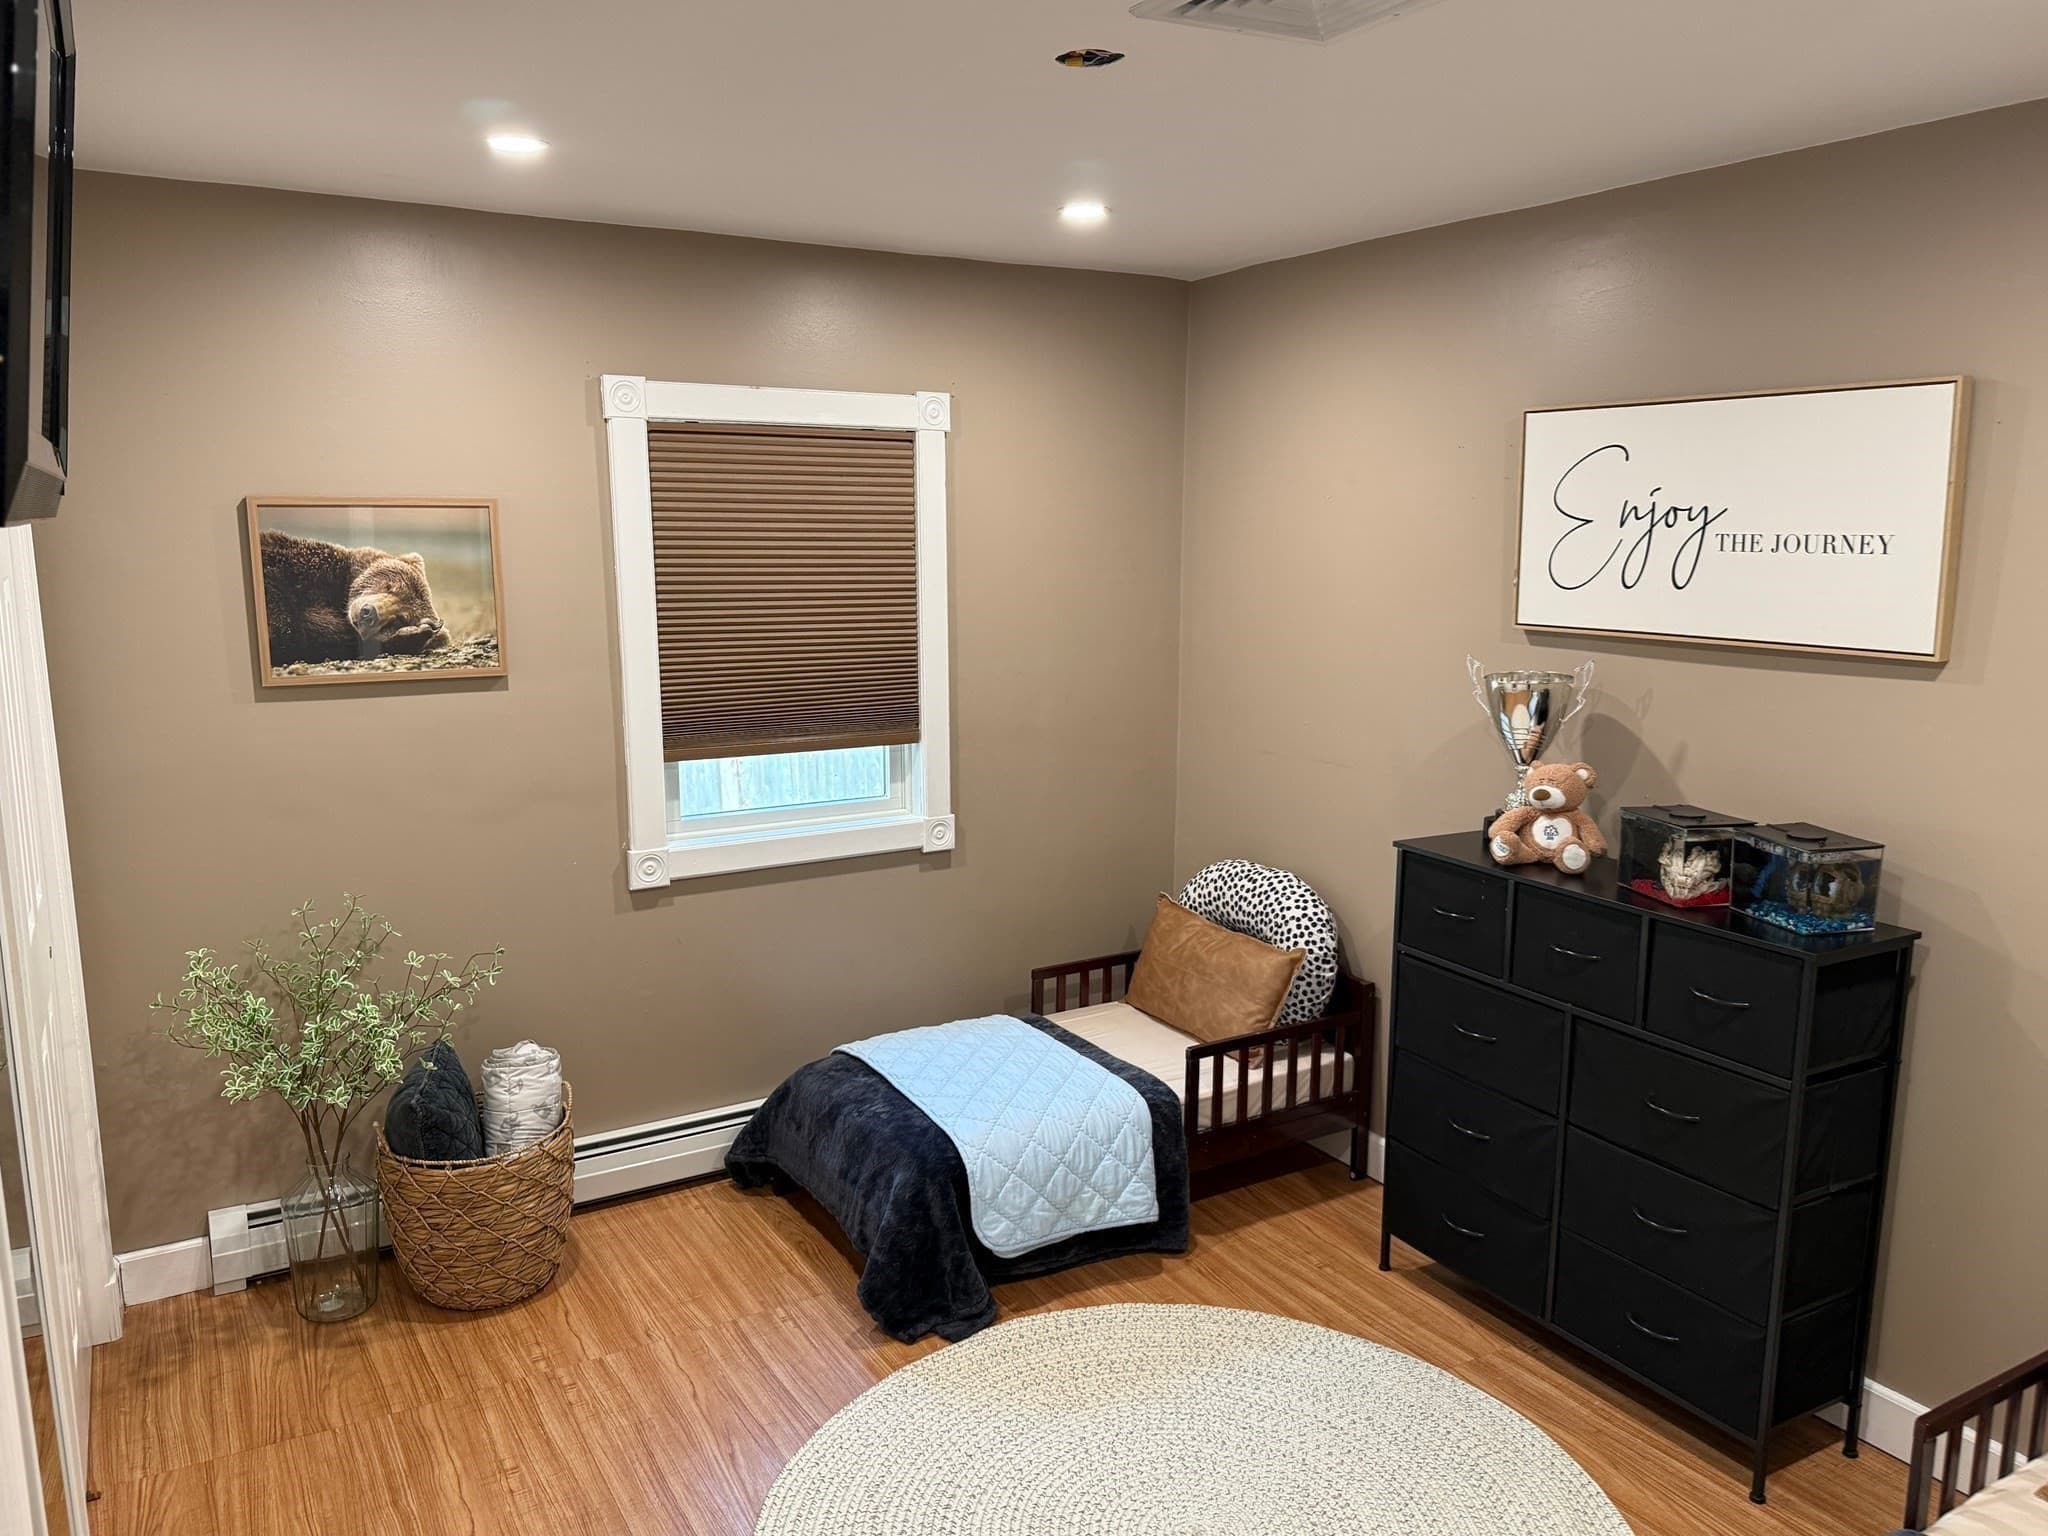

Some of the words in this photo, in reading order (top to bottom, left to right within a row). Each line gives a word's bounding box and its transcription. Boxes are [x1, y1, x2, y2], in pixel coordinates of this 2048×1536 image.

[1548, 444, 1728, 590] Enjoy
[1715, 533, 1763, 553] THE
[1770, 533, 1896, 555] JOURNEY
